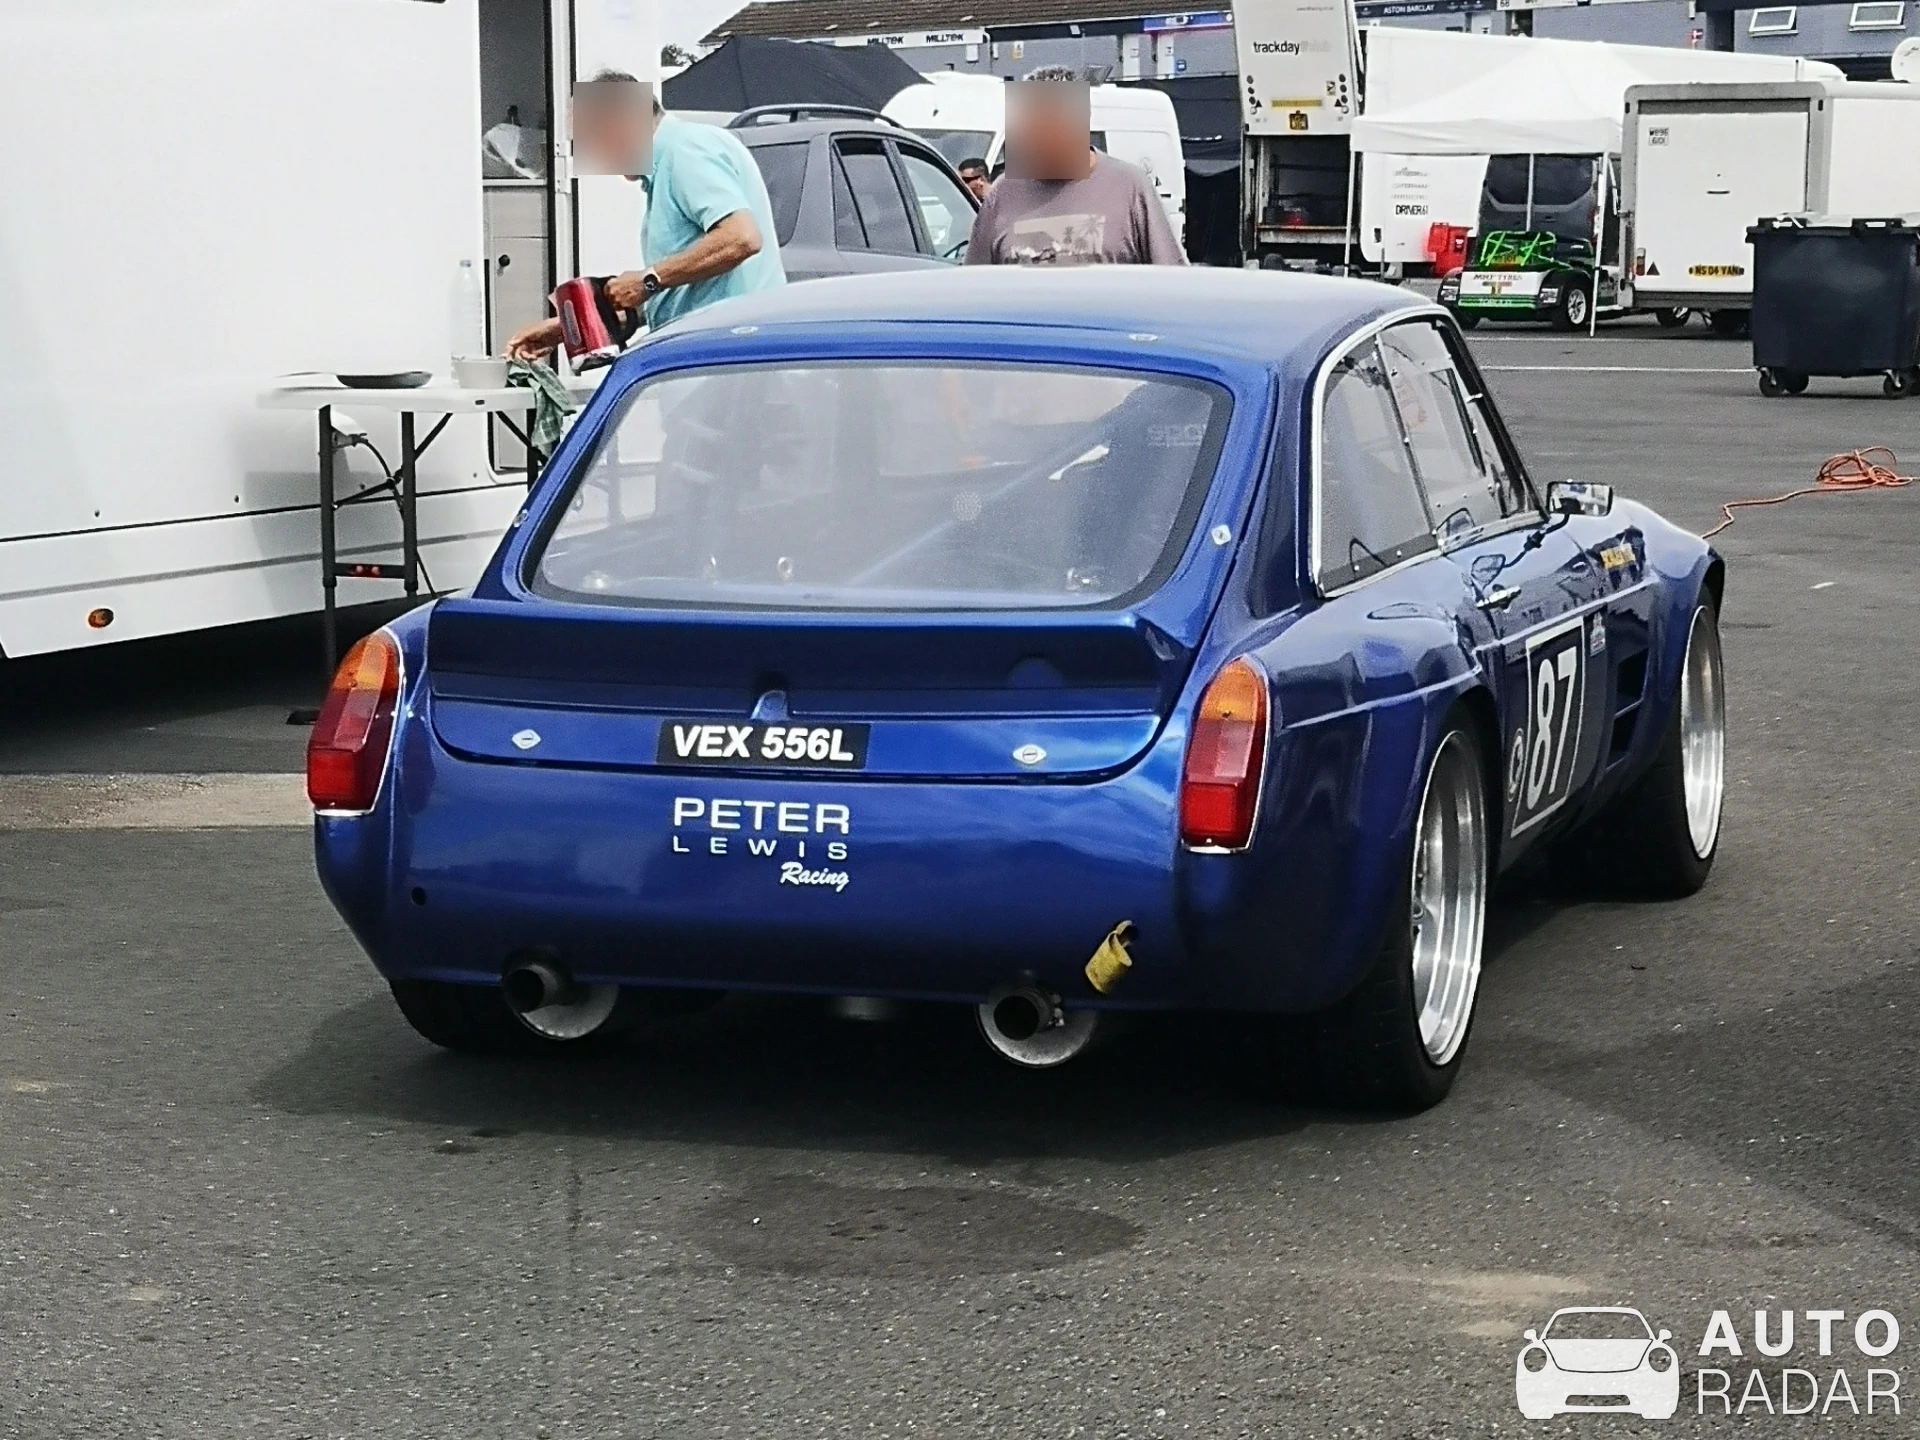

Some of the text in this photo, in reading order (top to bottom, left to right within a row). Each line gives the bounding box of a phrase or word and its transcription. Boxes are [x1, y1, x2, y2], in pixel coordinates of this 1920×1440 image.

[925, 33, 964, 43] MILLTEK
[673, 725, 854, 761] VEX 556L
[1527, 646, 1577, 810] 87
[674, 797, 850, 834] PETER
[673, 835, 847, 860] LEWIS
[780, 861, 849, 892] Racing
